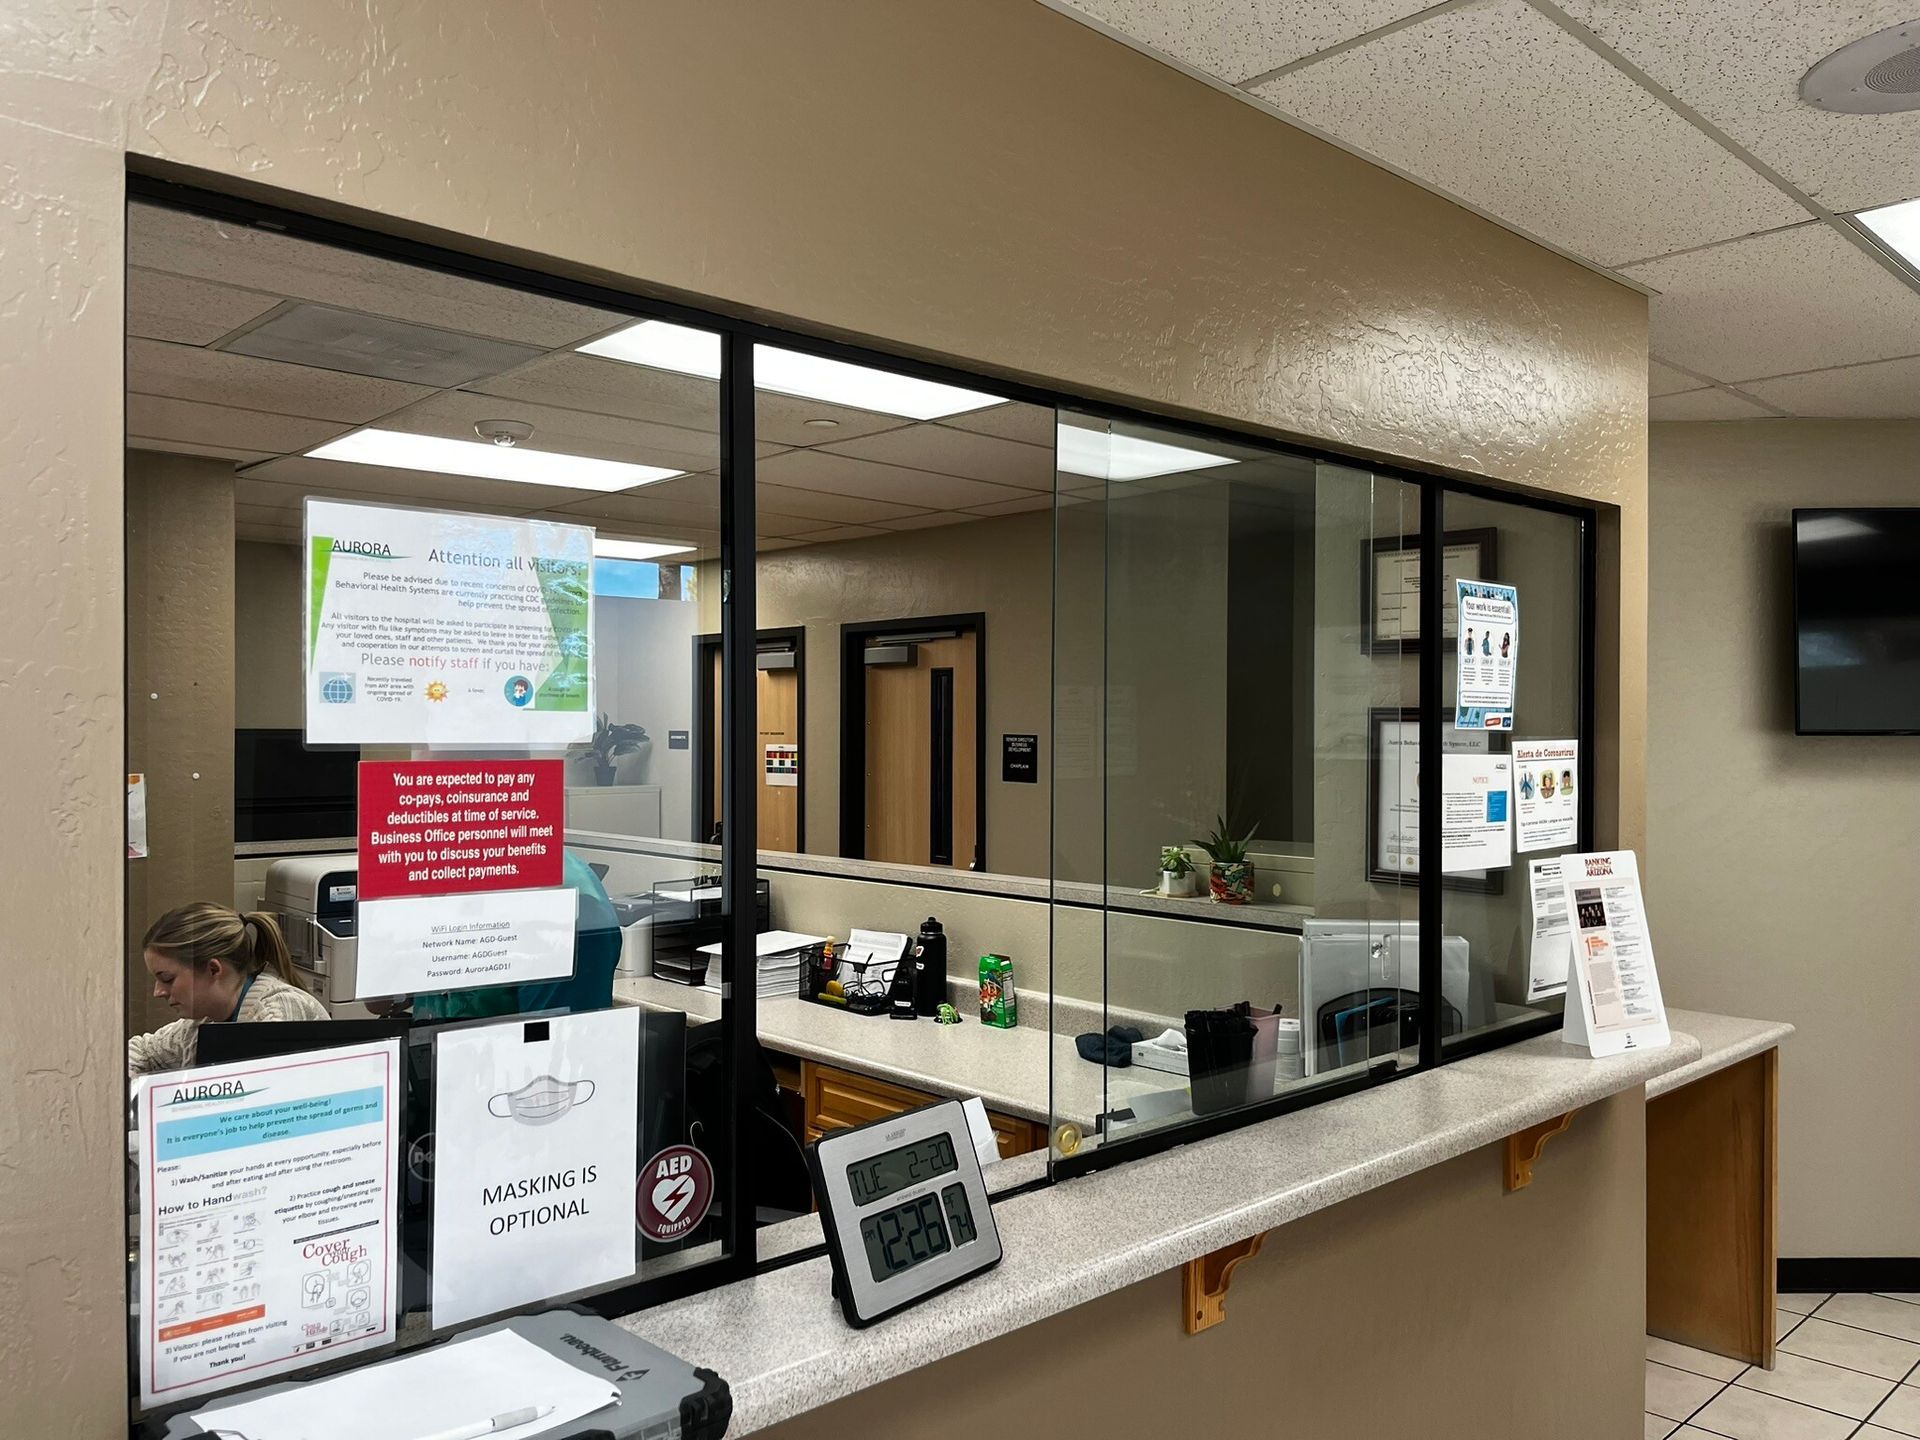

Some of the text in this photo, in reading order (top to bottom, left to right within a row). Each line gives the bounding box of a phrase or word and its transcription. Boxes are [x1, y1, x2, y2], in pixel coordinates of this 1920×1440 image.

[332, 540, 391, 556] AURORA
[428, 549, 500, 567] Attention
[506, 556, 523, 570] all
[335, 580, 378, 590] Behavioral
[380, 583, 407, 592] Health
[409, 586, 440, 595] Systems
[455, 590, 488, 600] currently
[490, 593, 524, 603] practicing
[363, 572, 390, 582] Please
[392, 574, 401, 582] be
[404, 576, 432, 585] advised
[435, 577, 448, 586] due
[460, 581, 484, 589] recent
[486, 583, 516, 592] concerns
[458, 599, 475, 608] help
[361, 652, 550, 672] Please notify staff if you have:
[1544, 749, 1574, 757] Coronavirus
[393, 771, 535, 788] You are expected to pay any
[399, 789, 529, 808] co-pays, coinsurance and
[387, 807, 539, 824] deductibles at time of service.
[371, 825, 553, 845] Business Office personnel will meet
[378, 842, 546, 866] with you to discuss your benefits
[408, 862, 519, 881] and collect payments.
[469, 921, 510, 930] Information
[422, 939, 453, 948] Network
[479, 934, 517, 943] AGD-Guest
[431, 949, 507, 962] Username: AGDGuest
[426, 962, 511, 977] Password: AuroraAGD1!
[172, 1080, 244, 1104] AURORA
[251, 1109, 273, 1118] about
[274, 1106, 290, 1115] your
[292, 1098, 331, 1111] well-being!
[182, 1128, 224, 1141] everyone's
[225, 1126, 237, 1135] job
[248, 1122, 265, 1130] help
[266, 1116, 294, 1128] prevent
[309, 1109, 333, 1120] spread
[342, 1105, 363, 1114] germs
[365, 1101, 378, 1109] and
[262, 1130, 290, 1139] disease.
[157, 1164, 181, 1173] Please:
[178, 1170, 228, 1184] Wash/Sanitize
[229, 1167, 244, 1176] your
[245, 1163, 265, 1171] hands
[292, 1151, 329, 1162] opportunity,
[332, 1144, 361, 1154] especially
[362, 1140, 381, 1148] before
[656, 1155, 692, 1179] AED
[906, 1139, 952, 1178] 2-20
[296, 1190, 321, 1199] Practice
[322, 1185, 341, 1194] cough
[355, 1178, 375, 1187] sneeze
[483, 1165, 597, 1206] MASKING IS
[850, 1162, 888, 1196] TUE
[159, 1205, 184, 1216] How
[274, 1204, 304, 1214] etiquette
[313, 1189, 369, 1206] coughing/sneezing
[282, 1215, 296, 1224] your
[318, 1207, 330, 1215] and
[330, 1201, 357, 1212] throwing
[317, 1216, 339, 1225] tissues.
[490, 1198, 589, 1236] OPTIONAL
[657, 1216, 691, 1234] EQUIPPED
[877, 1198, 947, 1270] 12:26
[303, 1239, 350, 1259] Cover
[322, 1245, 367, 1266] Cough
[209, 1353, 245, 1368] Thank you!
[560, 1333, 629, 1372] Flambeau
